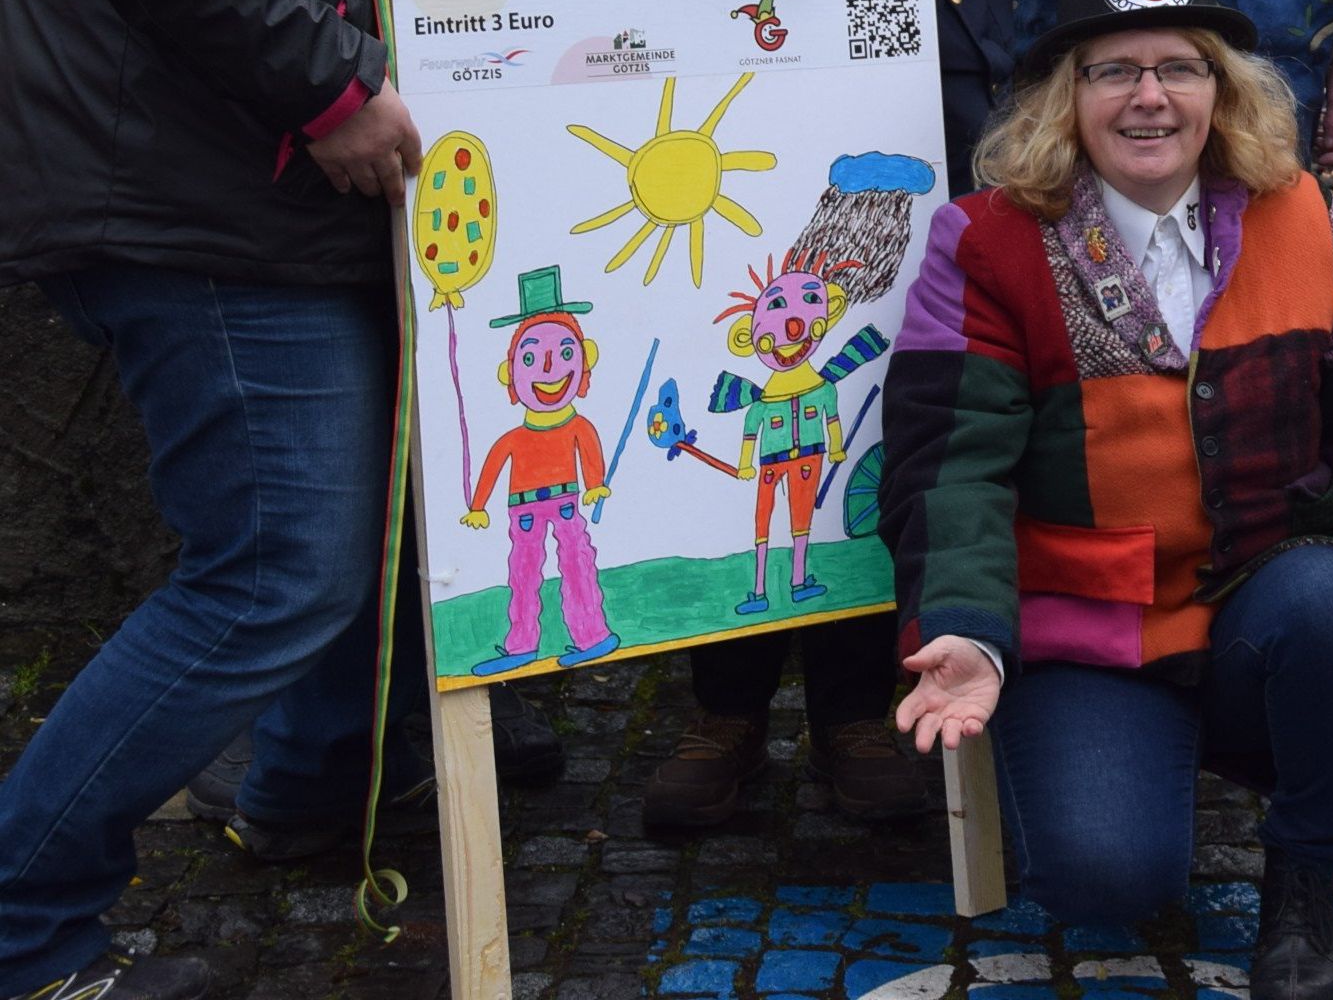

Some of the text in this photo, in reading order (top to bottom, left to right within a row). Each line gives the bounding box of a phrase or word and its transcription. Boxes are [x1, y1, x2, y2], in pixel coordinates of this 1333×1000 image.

[414, 12, 554, 35] Eintritt 3 Euro
[419, 56, 486, 71] Feuerwehr
[585, 50, 675, 64] MARKTGEMEINDE
[739, 55, 801, 66] GÖTZNER FASNAT
[452, 68, 502, 82] GÖTZIS
